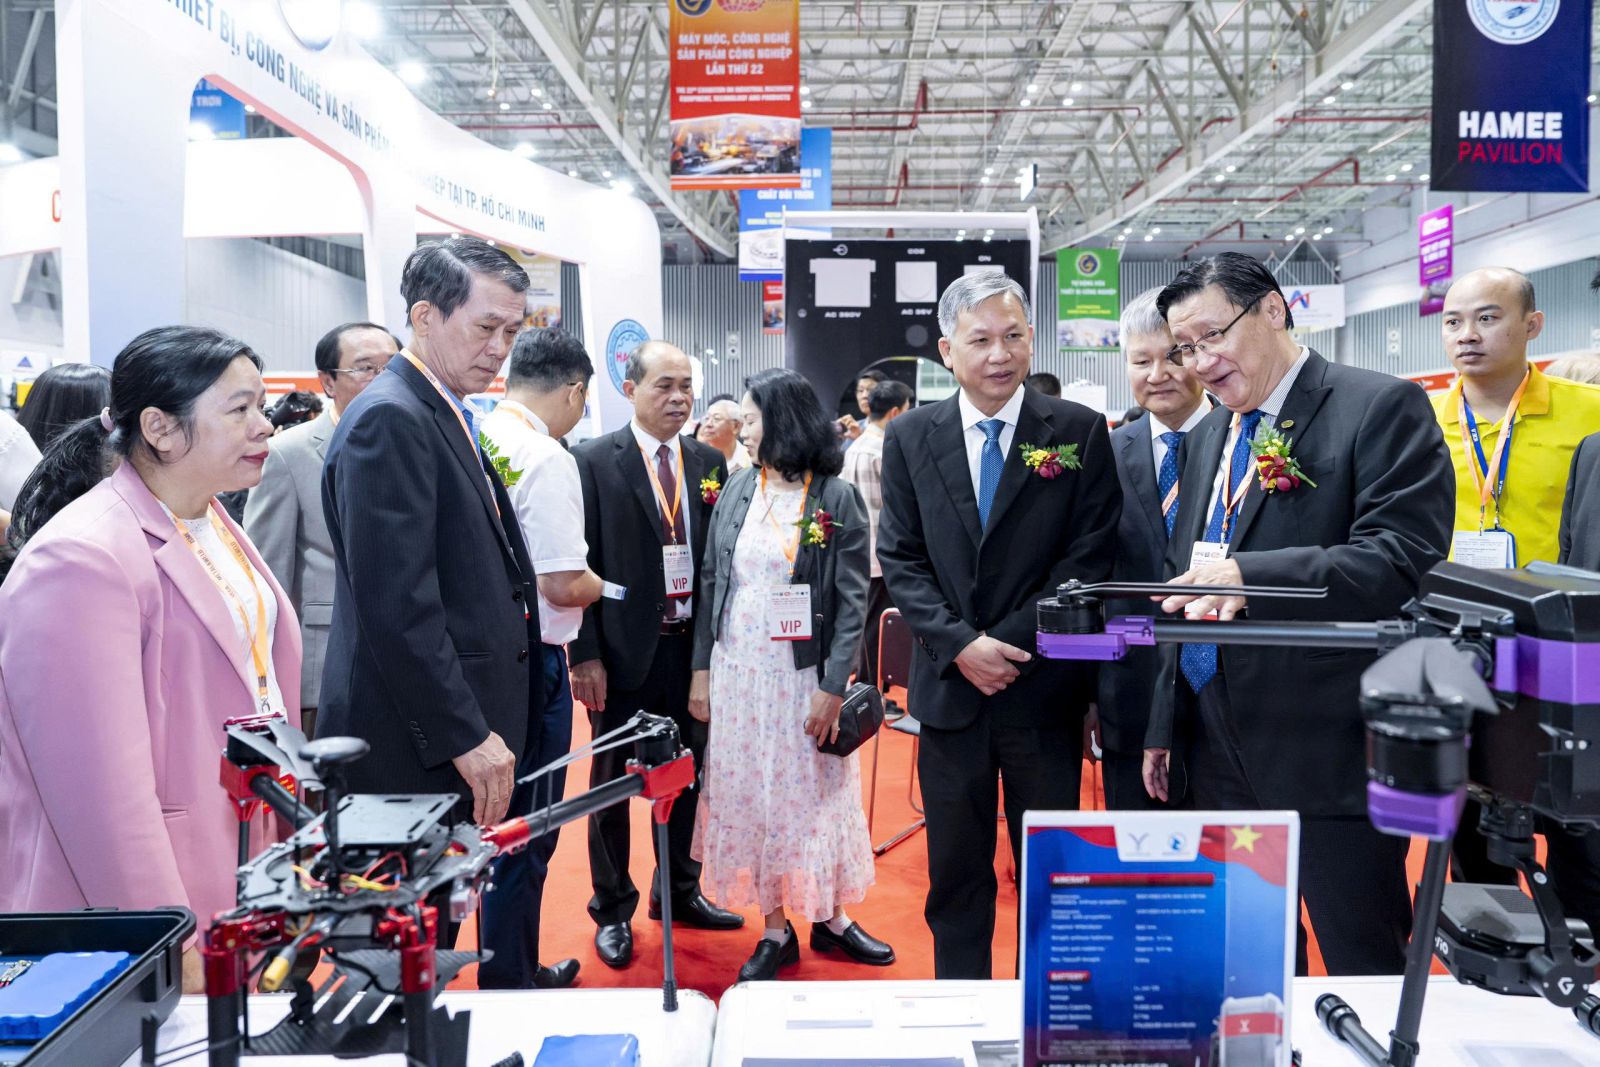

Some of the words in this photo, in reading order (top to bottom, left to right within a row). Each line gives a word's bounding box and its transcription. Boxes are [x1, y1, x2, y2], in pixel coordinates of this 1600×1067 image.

[732, 32, 761, 45] CÔNG
[751, 63, 764, 75] 22
[1458, 110, 1563, 139] HAMEE
[1457, 141, 1562, 164] PAVILION
[518, 208, 545, 232] MINH
[672, 577, 688, 591] VIP
[780, 620, 802, 634] VIP
